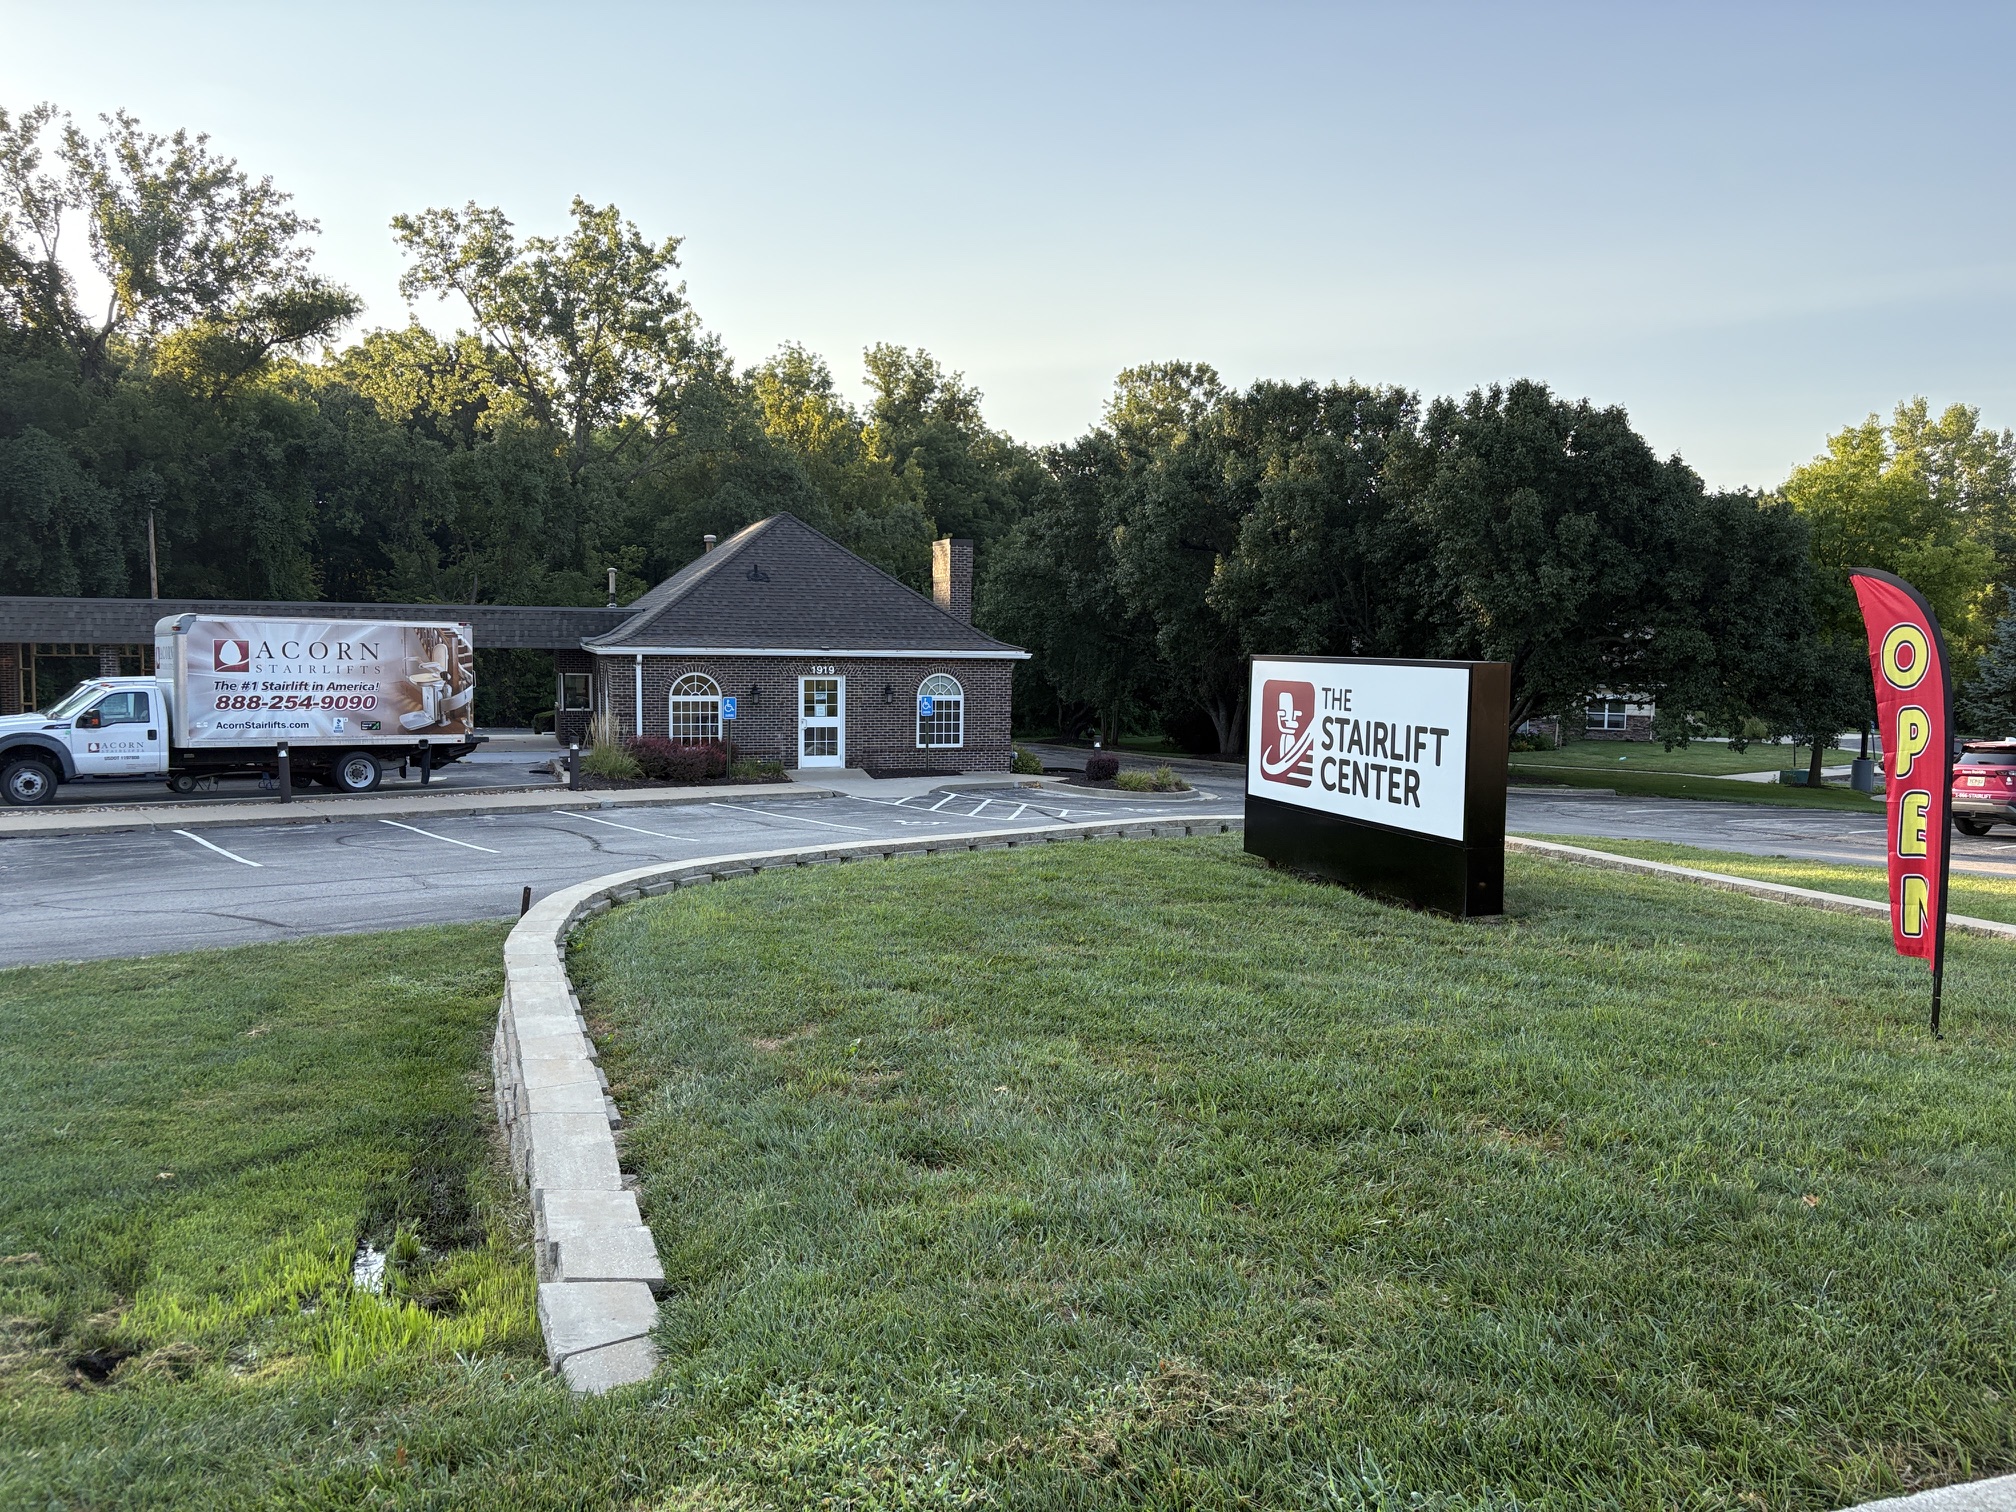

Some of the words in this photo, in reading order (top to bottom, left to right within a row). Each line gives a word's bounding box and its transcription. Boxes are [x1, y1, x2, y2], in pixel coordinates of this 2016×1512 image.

[255, 640, 381, 660] ACORN
[255, 664, 381, 674] STAIRLIFTS
[811, 665, 835, 675] 1919
[214, 681, 237, 691] The
[241, 681, 258, 691] #1
[261, 681, 309, 691] Stairlift
[312, 682, 324, 691] in
[326, 682, 380, 691] America!
[214, 694, 378, 711] 888-254-9090
[1321, 687, 1353, 712] THE
[216, 721, 310, 730] AcornStairlifts.com
[1321, 716, 1450, 767] STAIRLIFT
[1321, 756, 1421, 808] CENTER
[1880, 622, 1931, 938] OPEN
